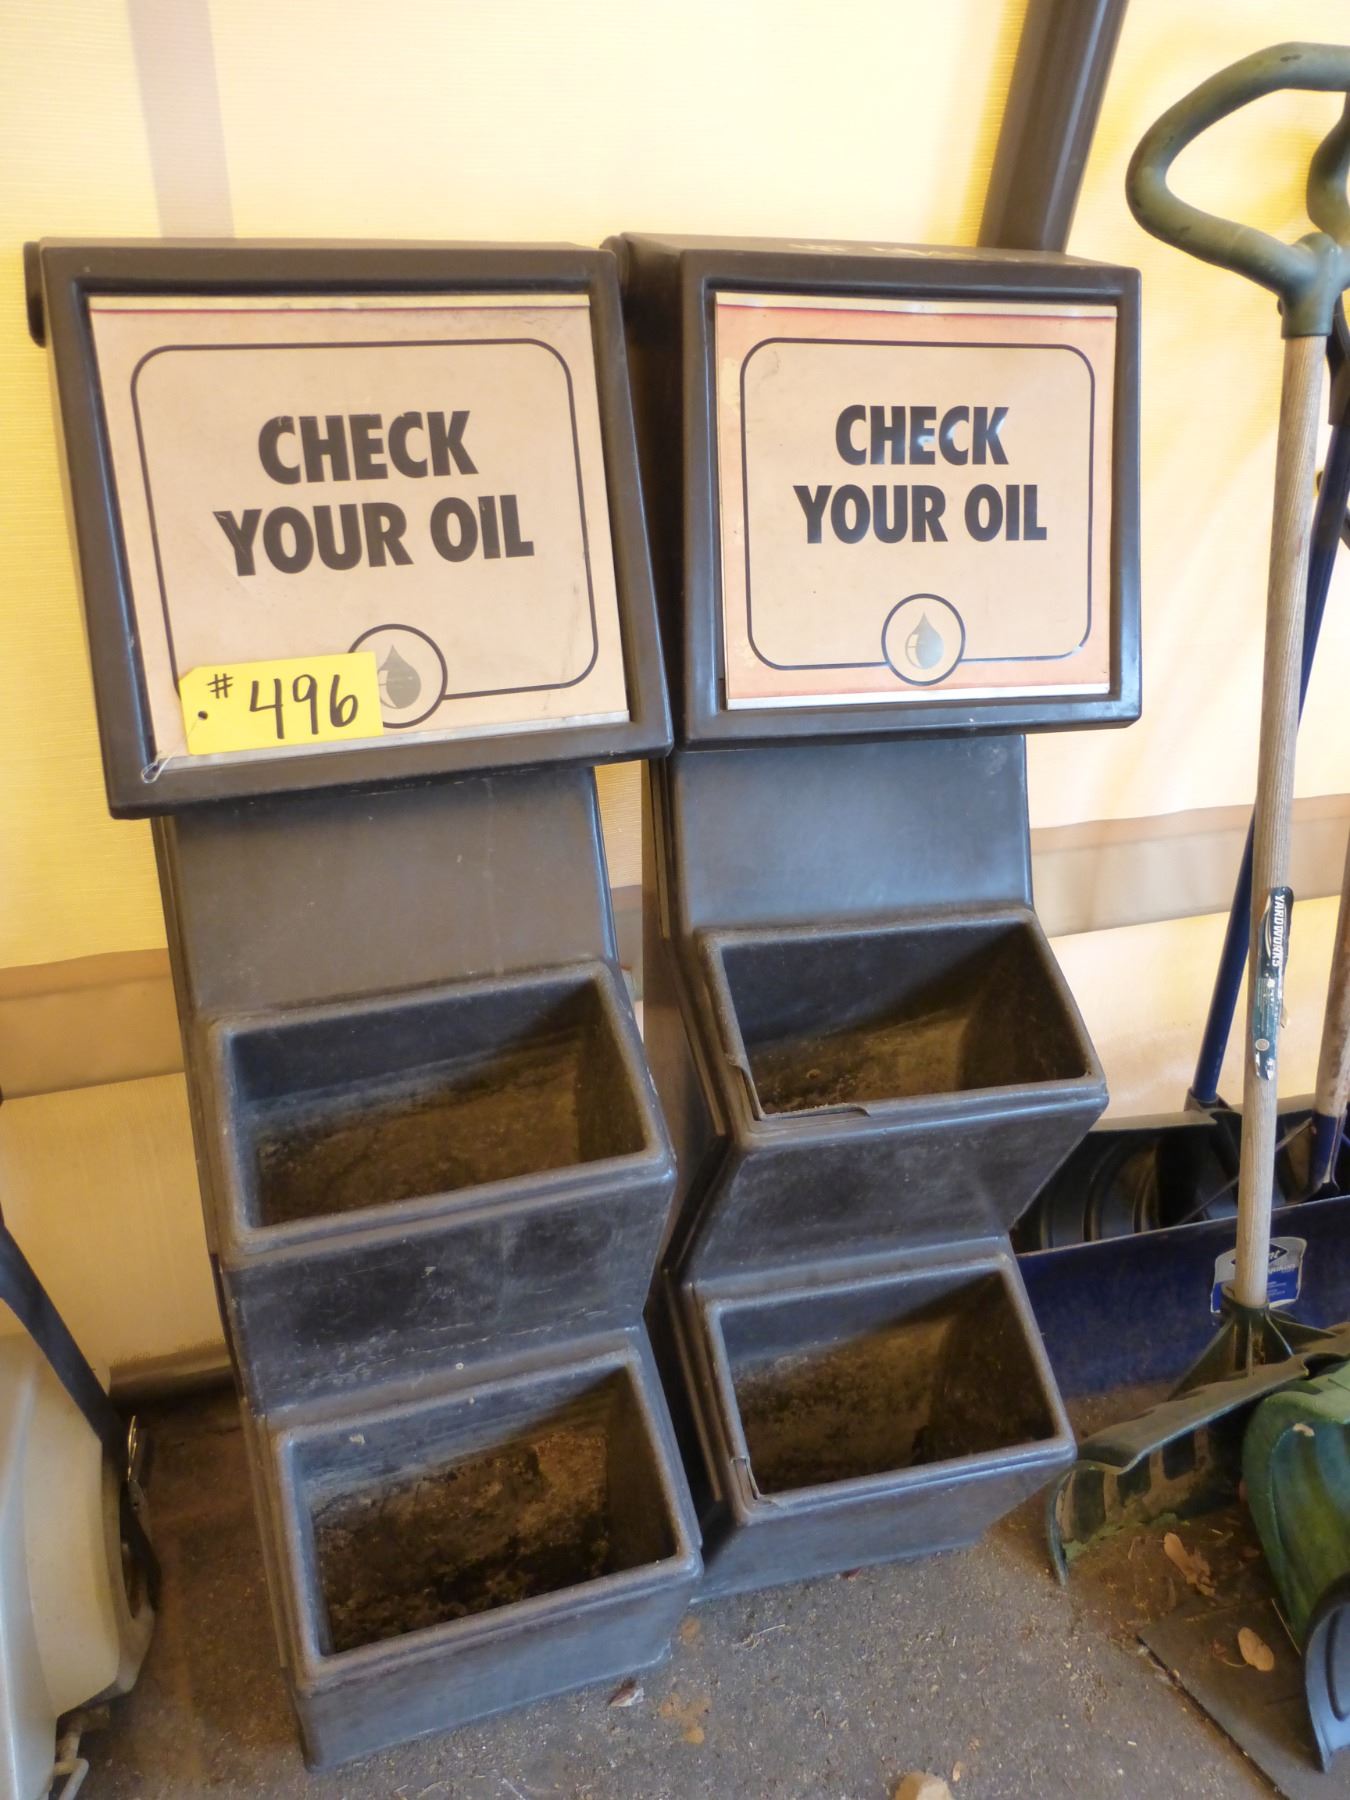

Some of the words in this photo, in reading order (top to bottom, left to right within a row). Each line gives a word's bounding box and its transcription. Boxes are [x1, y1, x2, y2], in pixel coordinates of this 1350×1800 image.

[258, 411, 478, 484] CHECK
[836, 405, 1008, 465] CHECK
[213, 503, 413, 576] YOUR
[430, 495, 534, 562] OIL
[793, 484, 948, 544] YOUR
[965, 484, 1047, 542] OIL
